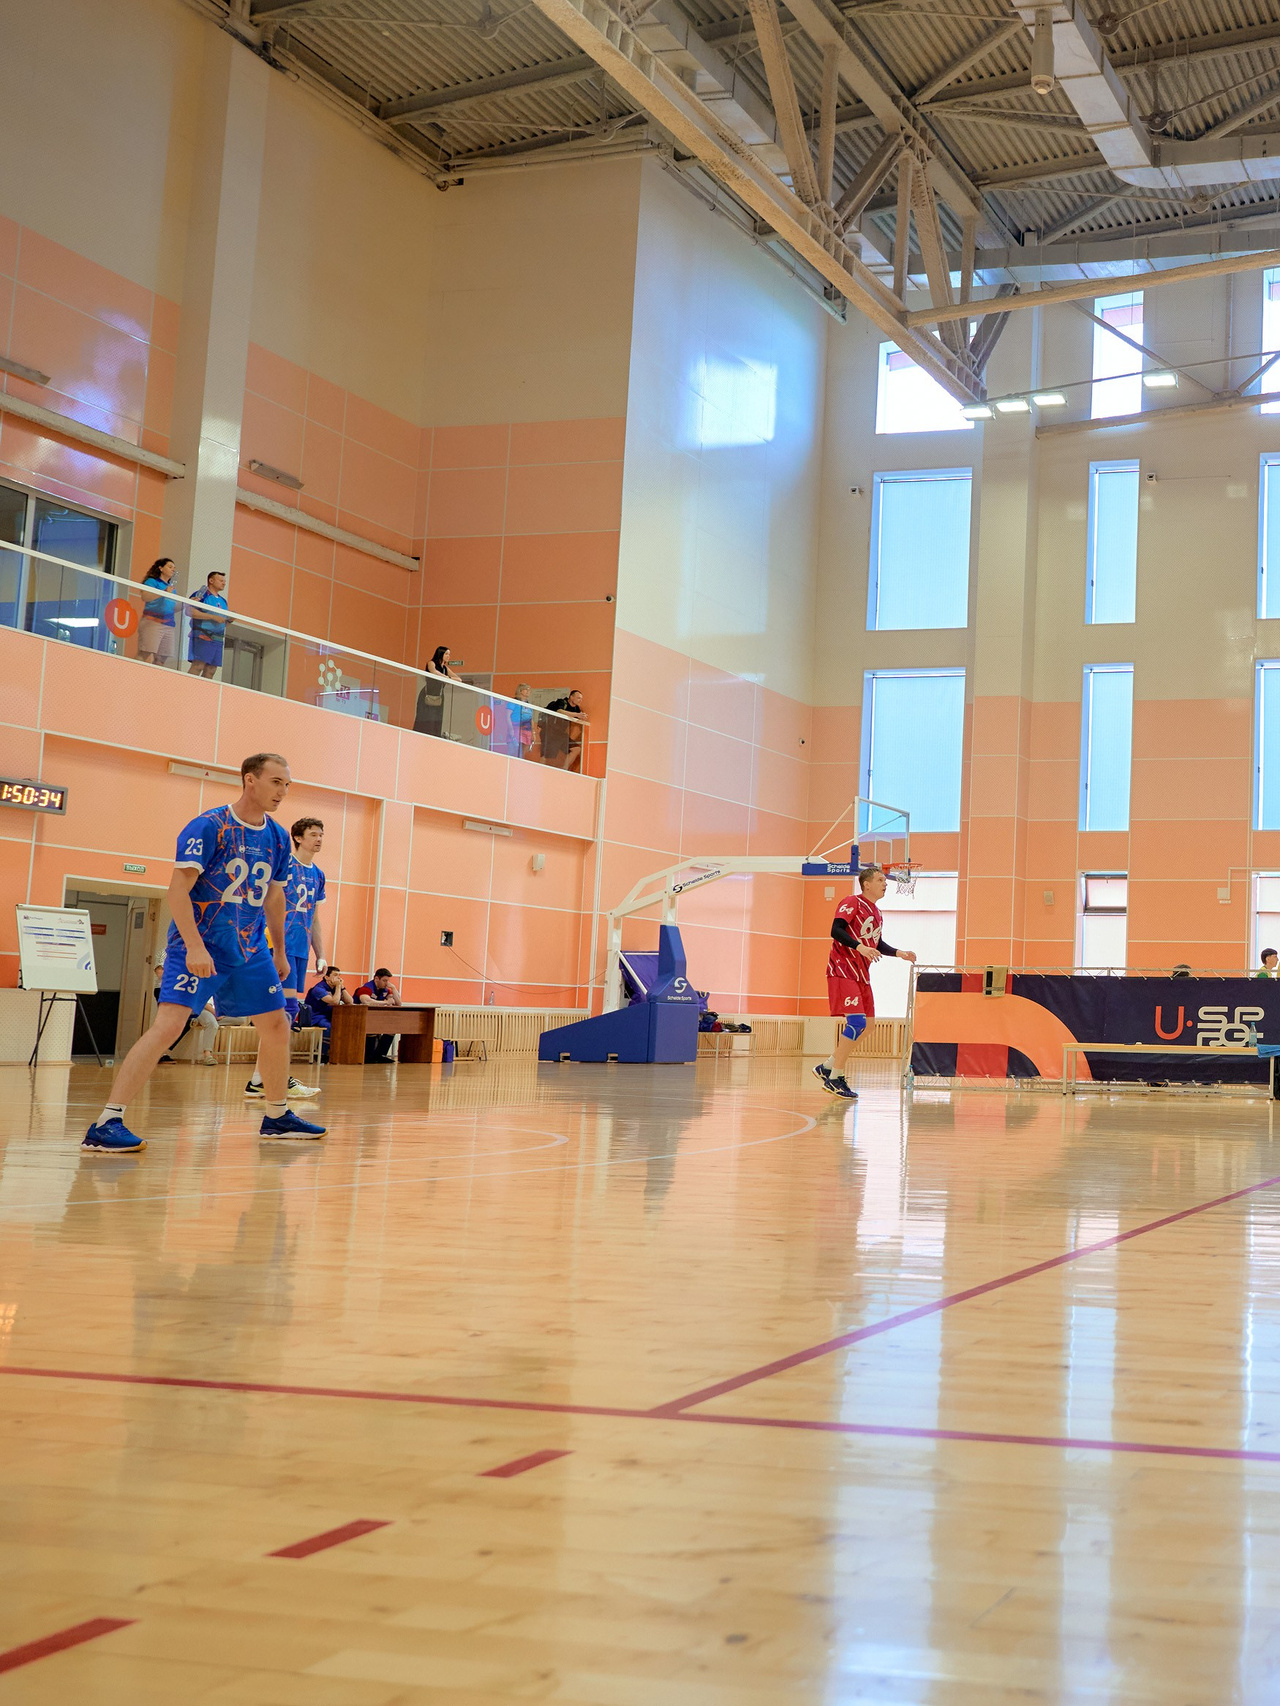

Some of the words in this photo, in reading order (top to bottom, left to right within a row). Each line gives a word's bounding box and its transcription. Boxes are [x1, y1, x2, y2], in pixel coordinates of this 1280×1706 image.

[114, 607, 130, 629] U
[481, 713, 491, 729] U
[185, 838, 203, 856] 23
[221, 857, 273, 908] 23
[839, 904, 854, 915] 64
[173, 973, 199, 994] 23
[844, 996, 859, 1007] 64
